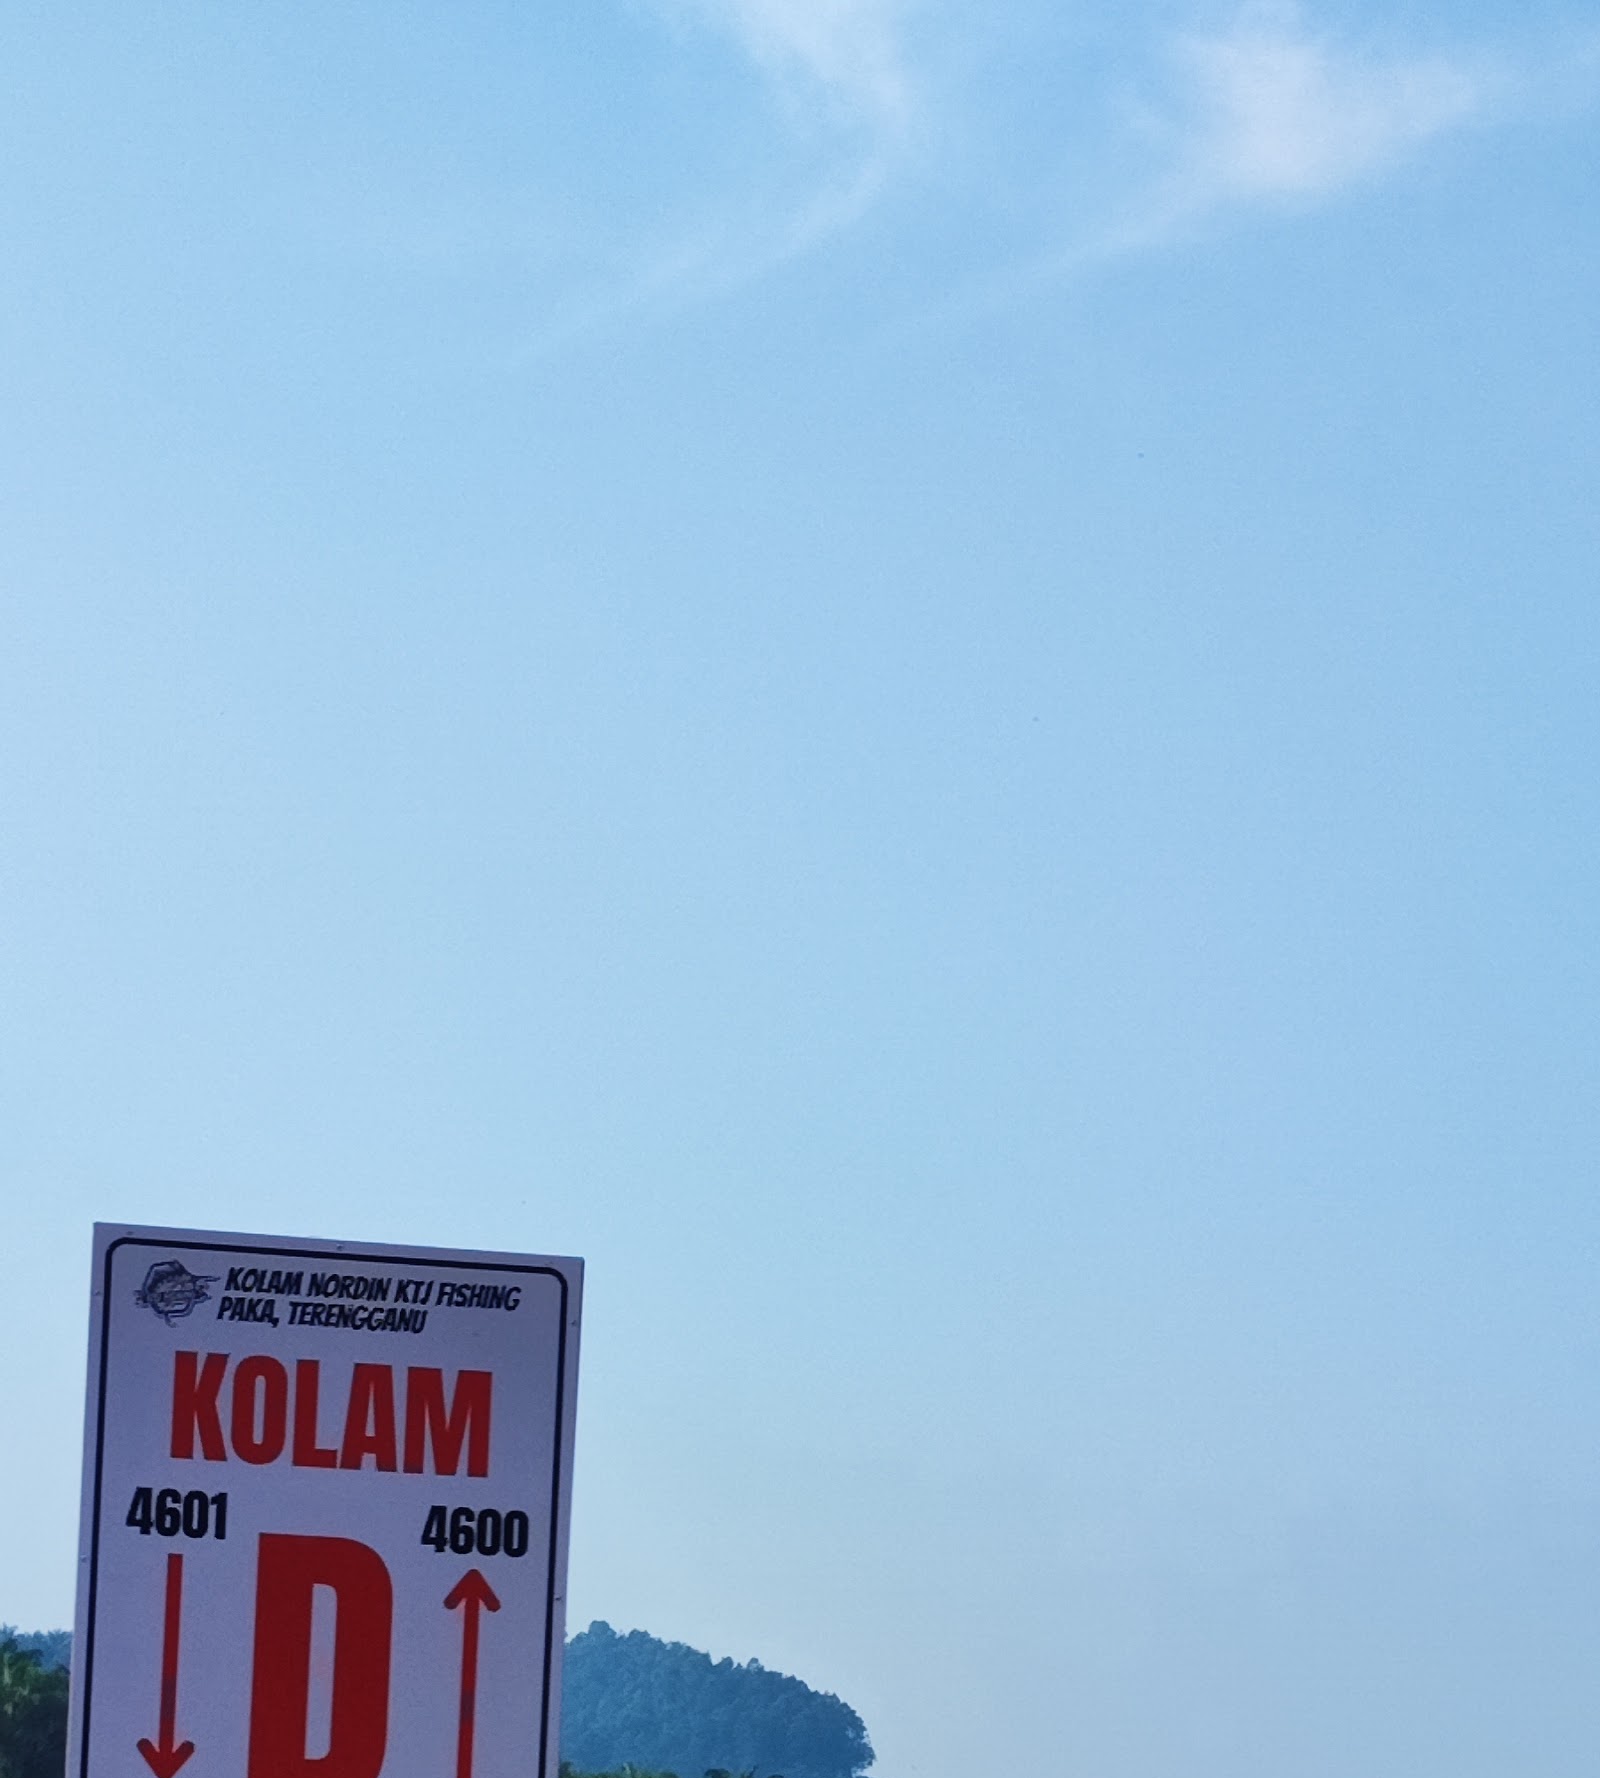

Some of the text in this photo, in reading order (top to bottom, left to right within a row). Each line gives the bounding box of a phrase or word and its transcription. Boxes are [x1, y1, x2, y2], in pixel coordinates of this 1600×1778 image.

[217, 1296, 280, 1328] PAKA,
[288, 1301, 428, 1334] TERENGGANU
[225, 1267, 522, 1311] KOLAM NORDIN KTJ FISHING
[170, 1351, 492, 1477] KOLAM
[126, 1487, 227, 1539] 4601
[421, 1505, 528, 1557] 4600
